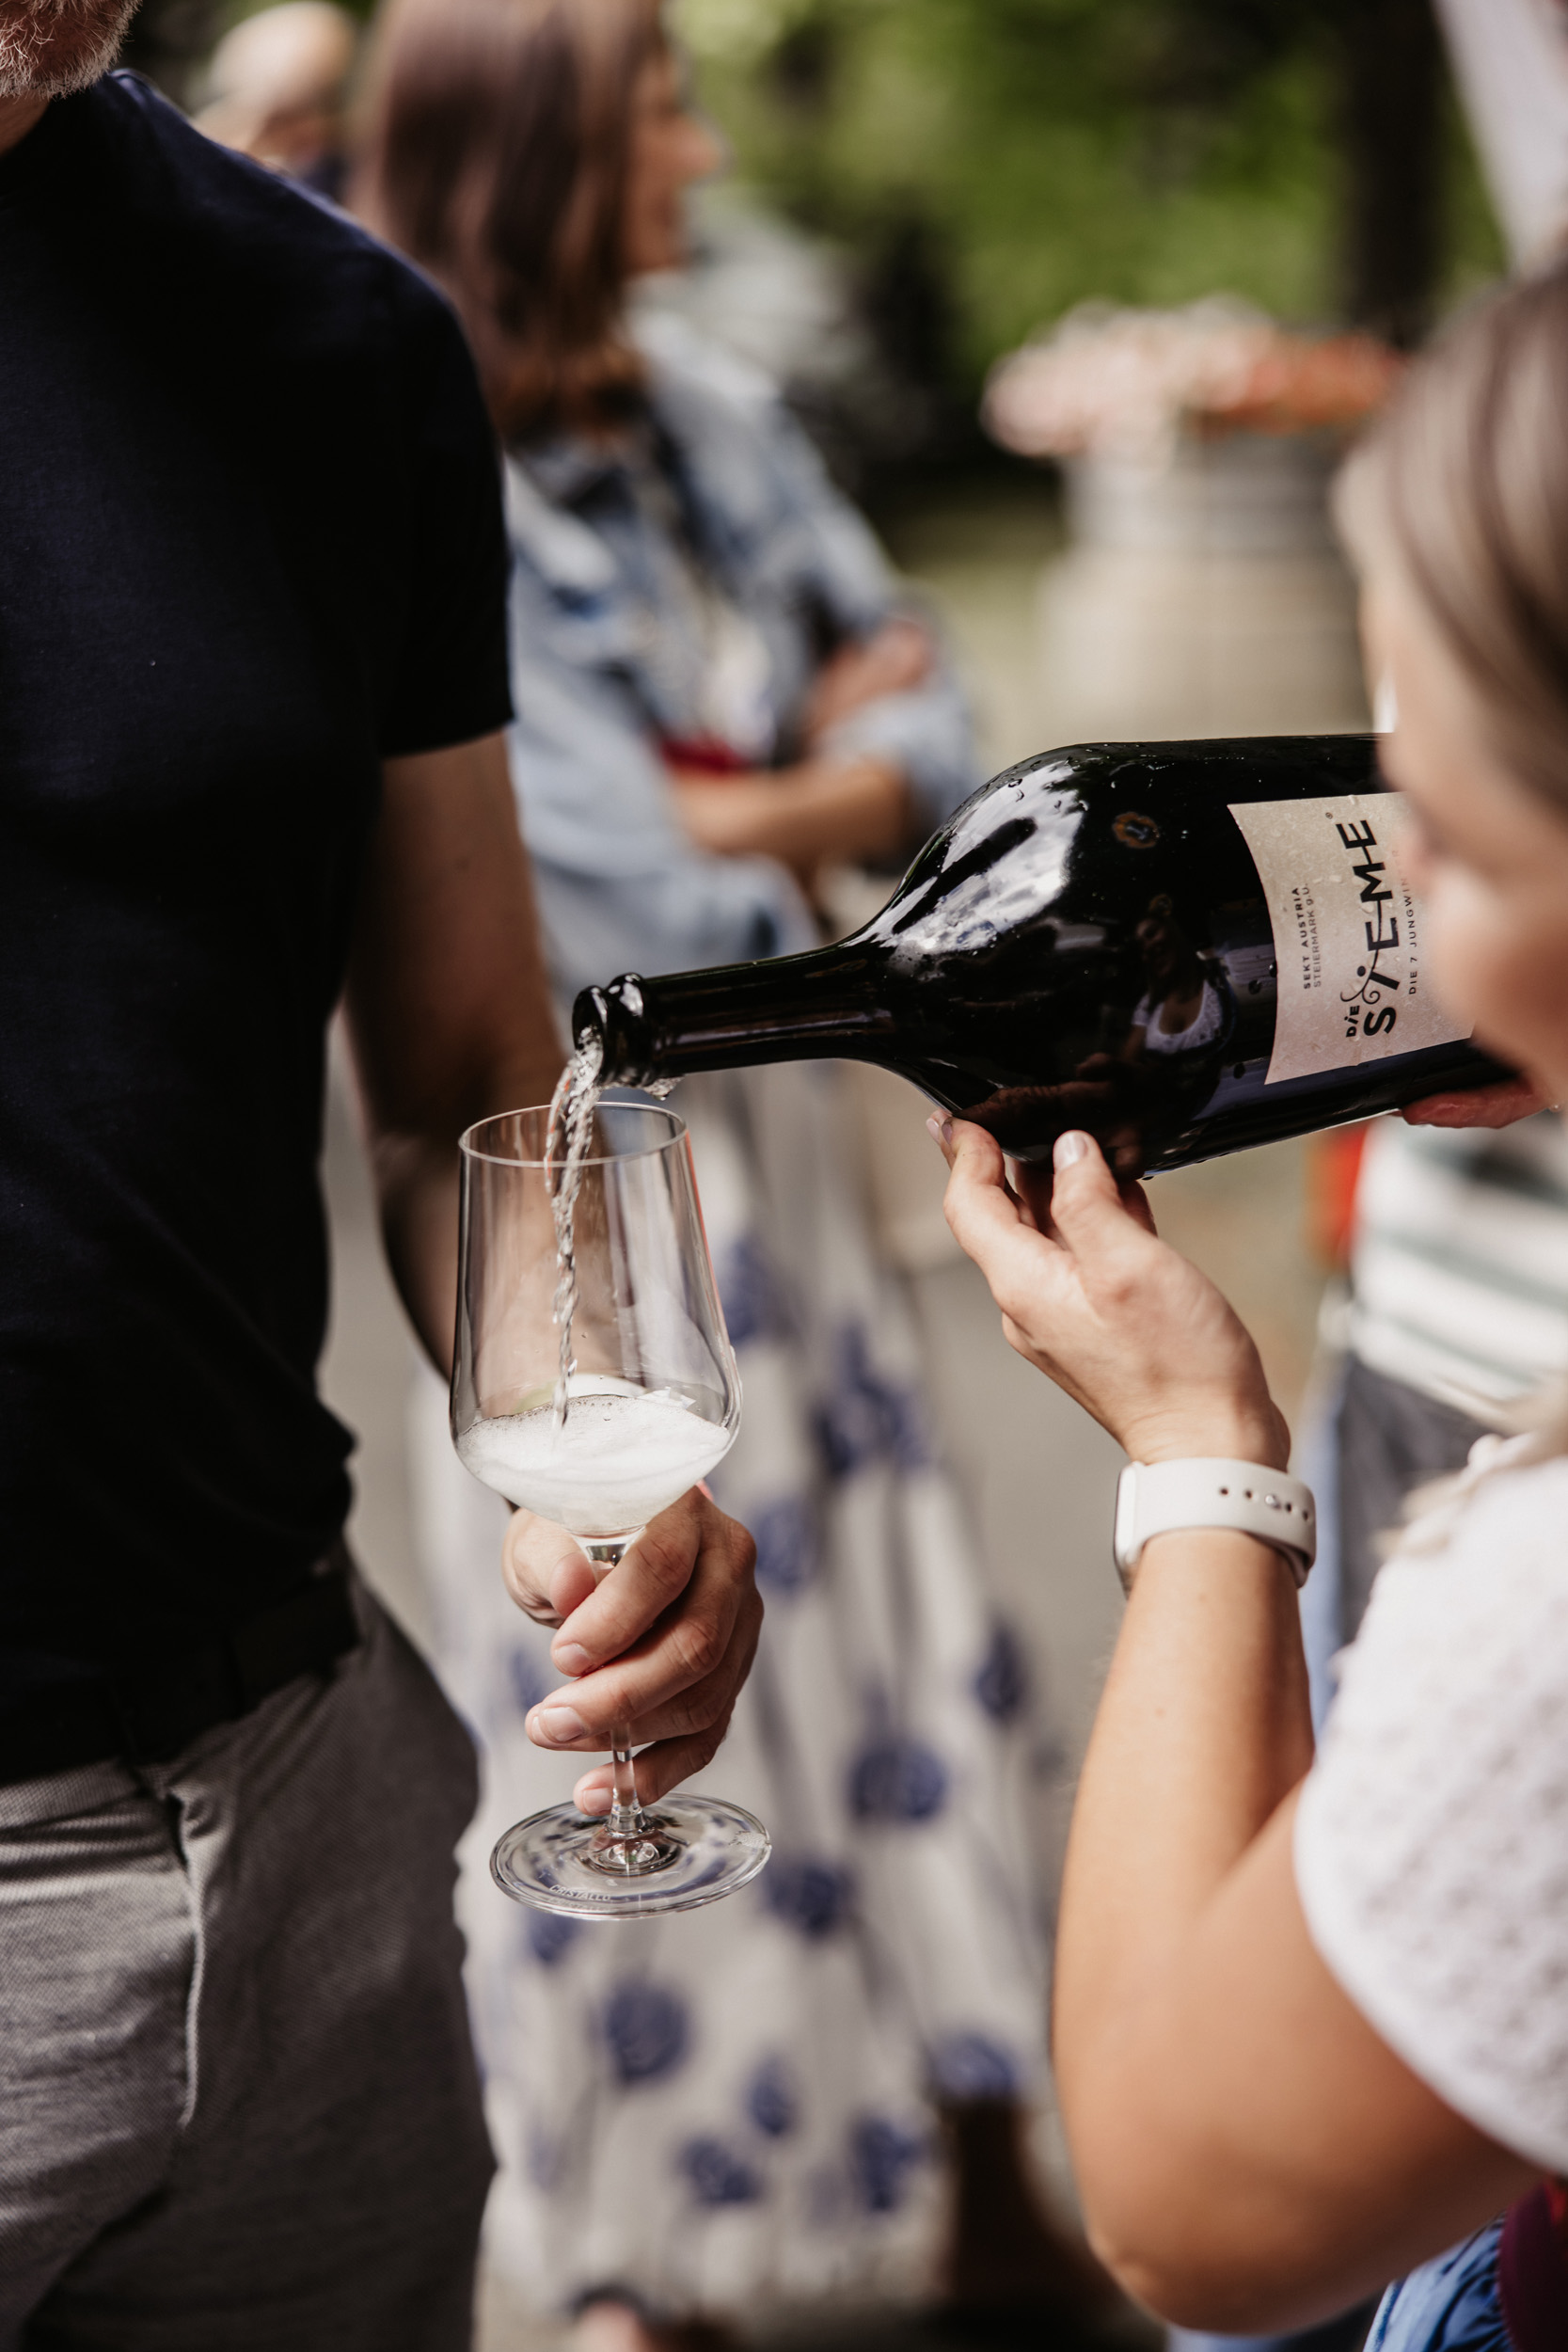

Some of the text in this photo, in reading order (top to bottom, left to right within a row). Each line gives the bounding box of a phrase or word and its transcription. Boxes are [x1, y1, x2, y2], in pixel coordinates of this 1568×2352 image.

[1291, 887, 1311, 990] SEKT AUSTRIA
[1307, 910, 1322, 988] STEIERMARK
[1409, 971, 1418, 994] DIE
[549, 1884, 610, 1901] CRISTALLO
